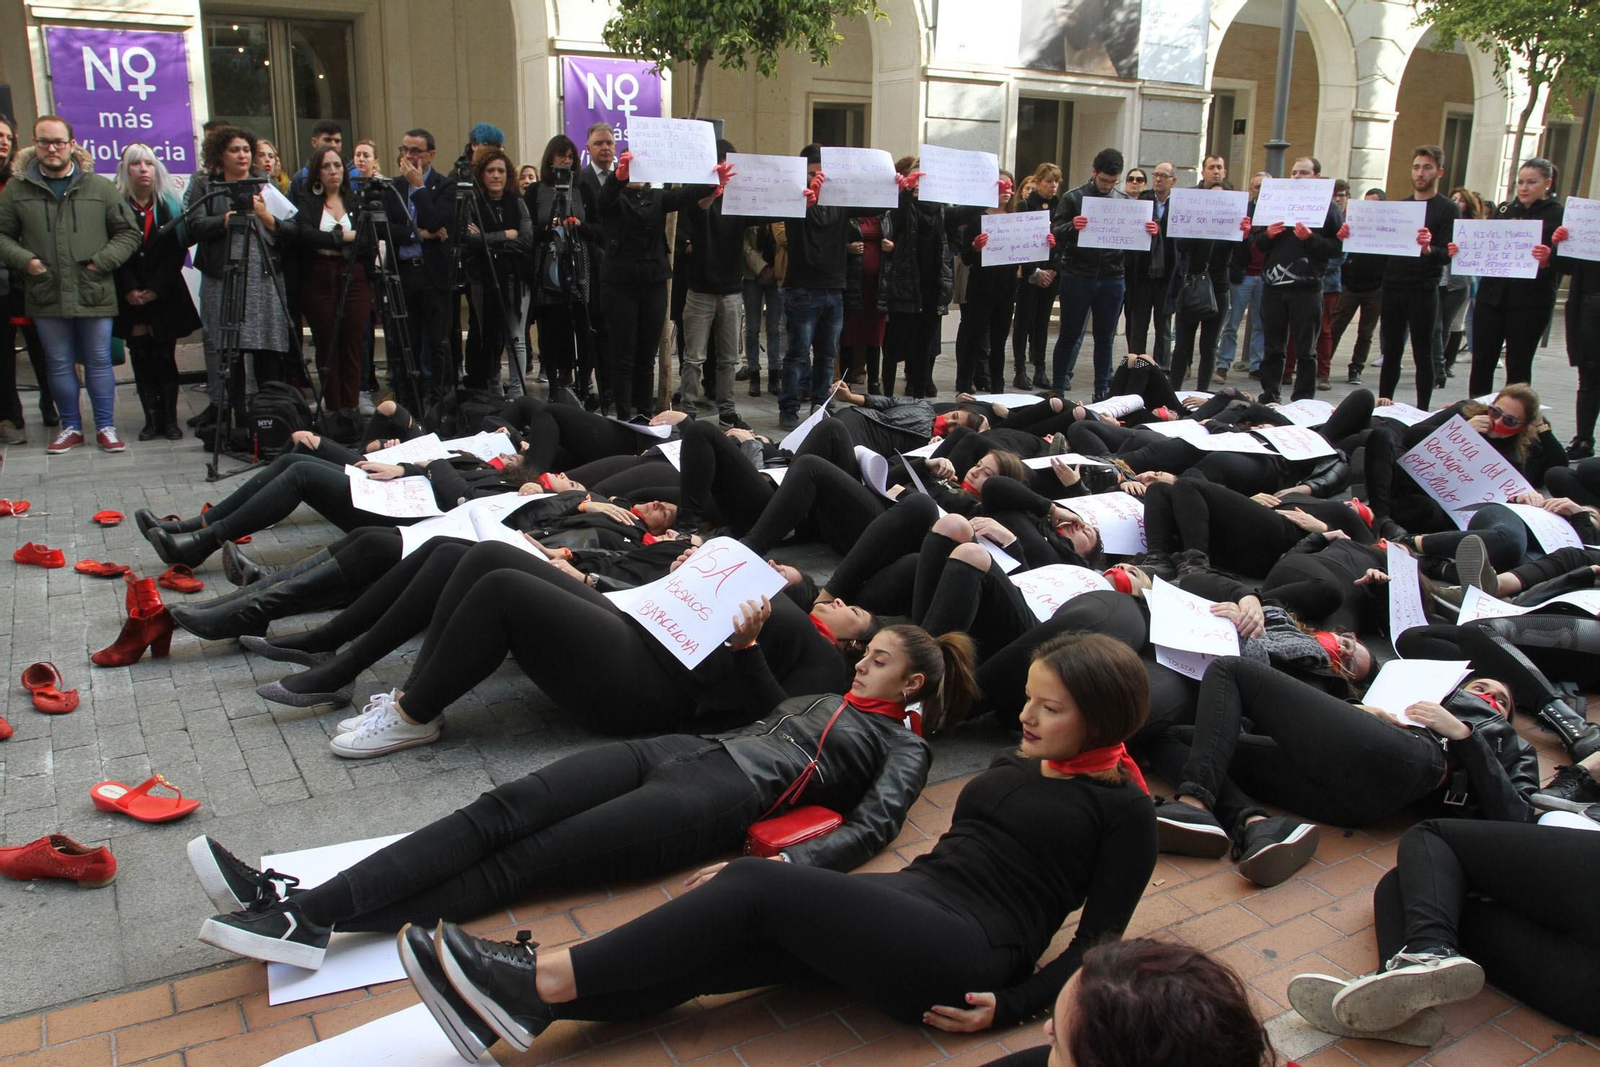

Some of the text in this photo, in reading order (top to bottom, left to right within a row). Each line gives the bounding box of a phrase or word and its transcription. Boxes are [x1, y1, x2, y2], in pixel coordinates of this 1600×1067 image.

[99, 106, 153, 129] más
[751, 196, 757, 204] 8
[1117, 217, 1126, 225] DE
[1196, 216, 1208, 225] son
[1457, 224, 1468, 239] A
[1473, 230, 1502, 239] NIVEL
[1097, 235, 1135, 245] MUJERES
[1459, 241, 1470, 250] EL
[1488, 240, 1501, 251] DE
[1503, 241, 1512, 250] LA
[1474, 251, 1483, 259] EL
[1501, 251, 1512, 260] DE
[1514, 252, 1525, 261] LA
[1516, 261, 1523, 269] A
[1480, 462, 1508, 481] del
[636, 599, 700, 656] BARCELONA
